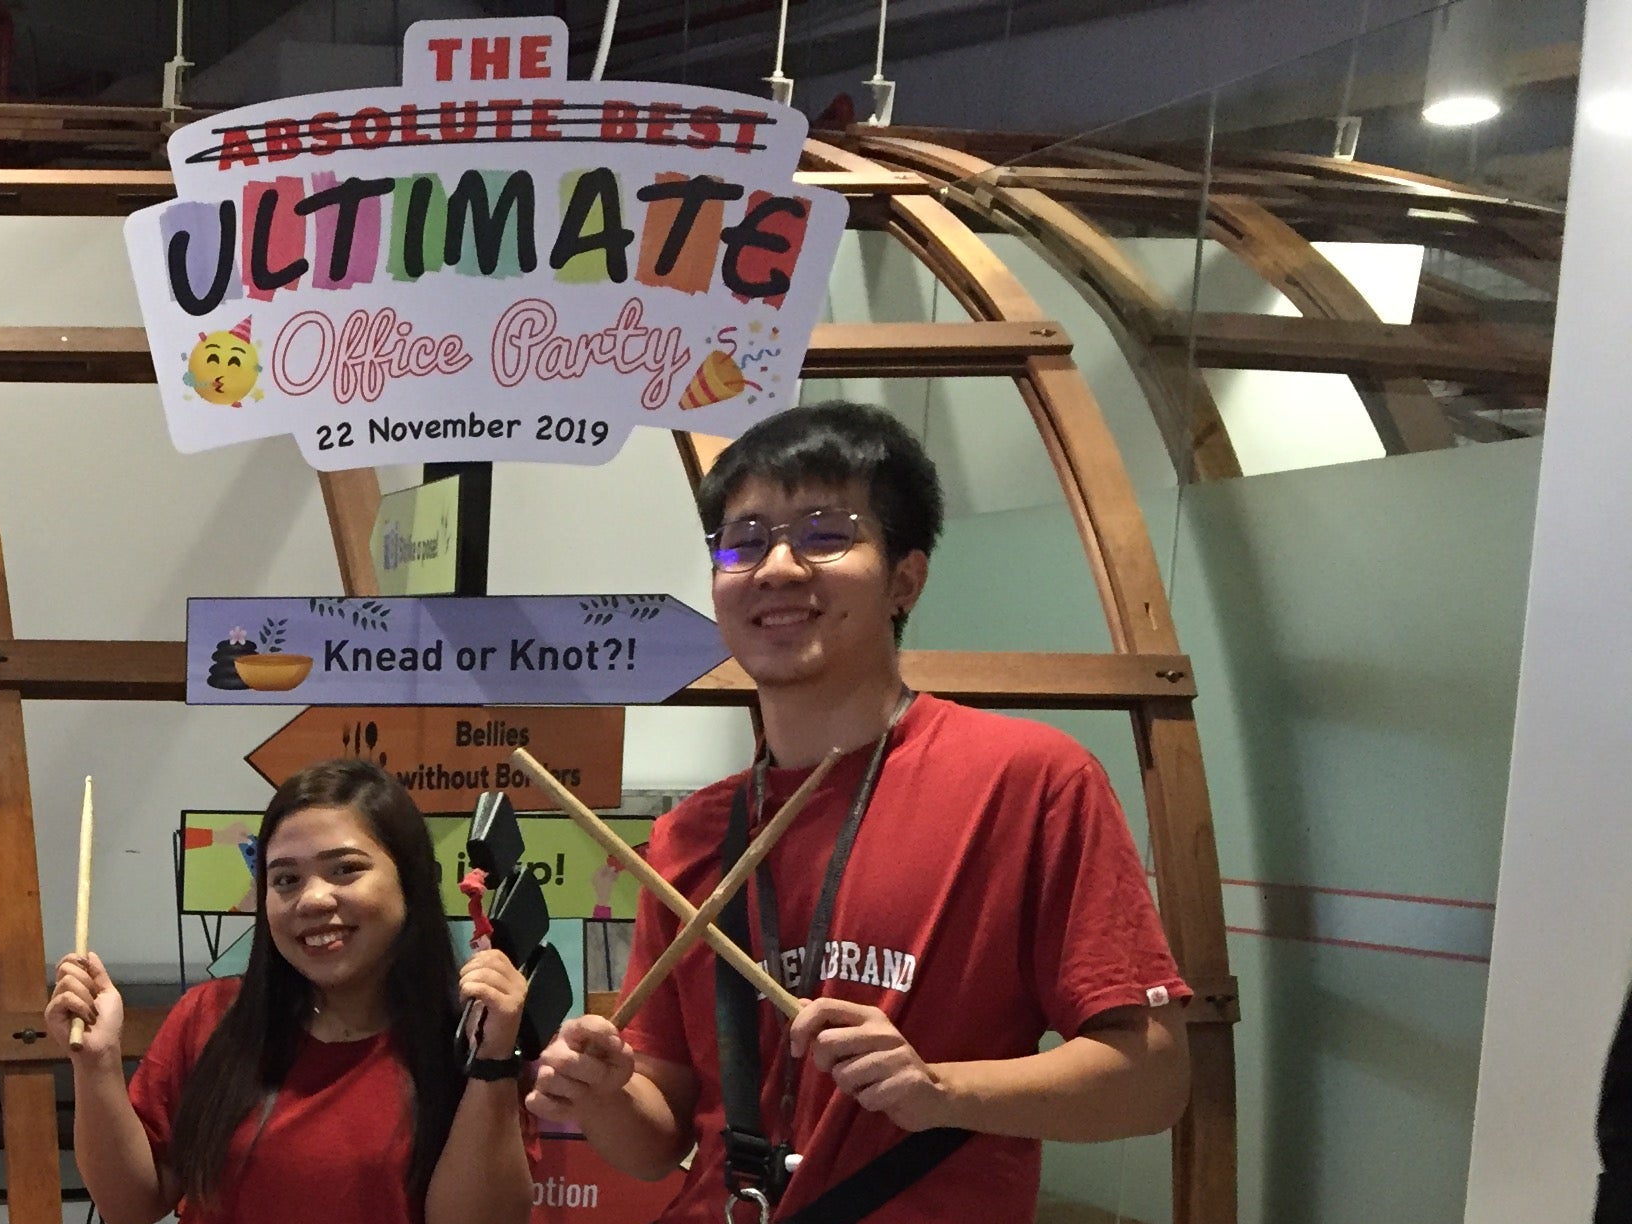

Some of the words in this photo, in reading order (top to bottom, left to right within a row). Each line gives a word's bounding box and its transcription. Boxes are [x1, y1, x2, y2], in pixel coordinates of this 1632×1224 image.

[427, 36, 553, 81] THE
[218, 99, 563, 170] ABSOLUTE
[600, 100, 772, 154] BEST
[168, 167, 808, 316] ULTIMATE
[272, 306, 473, 403] Office
[490, 297, 690, 411] Party
[317, 422, 354, 450] 22
[368, 411, 521, 444] November
[535, 414, 609, 446] 2019
[324, 639, 443, 672] Knead
[456, 646, 498, 672] or
[510, 638, 636, 672] Knot?!
[456, 720, 530, 747] Bellies
[397, 763, 490, 791] without
[496, 763, 581, 788] Borrs
[517, 853, 565, 886] p!
